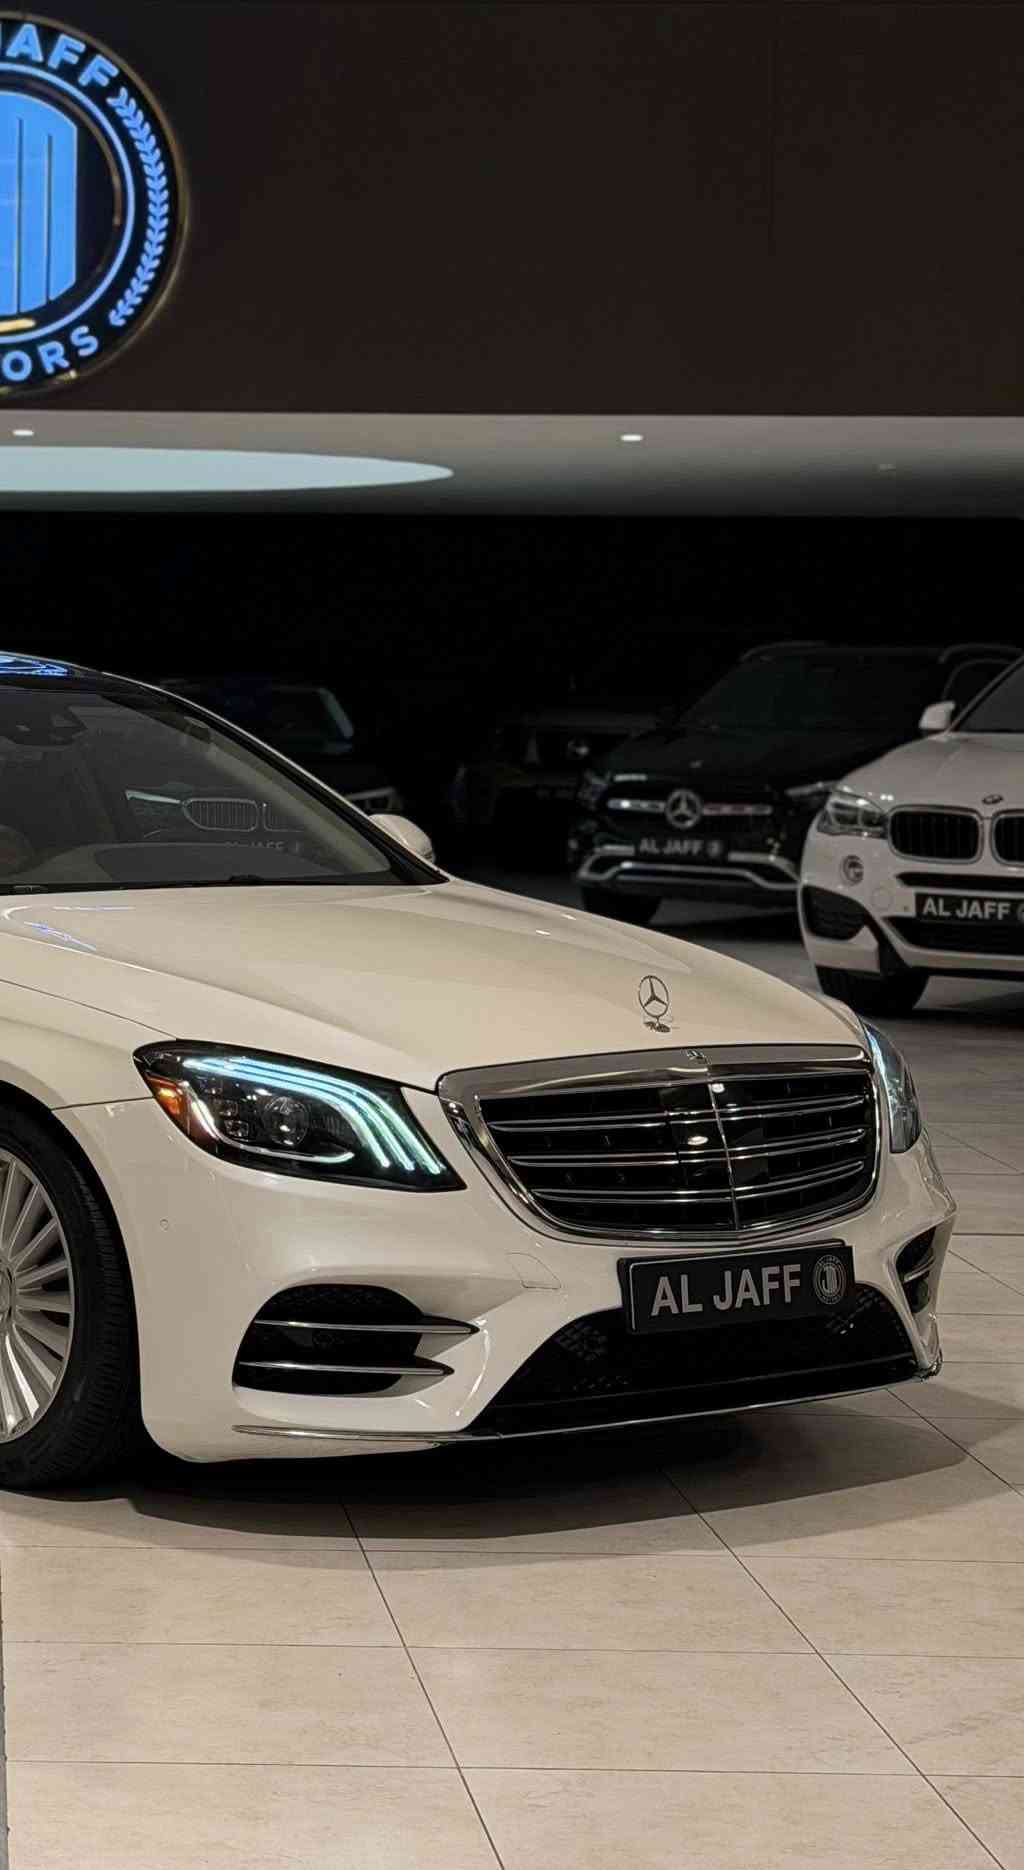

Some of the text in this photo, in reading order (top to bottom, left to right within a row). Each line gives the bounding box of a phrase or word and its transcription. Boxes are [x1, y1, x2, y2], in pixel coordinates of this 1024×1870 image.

[662, 838, 704, 855] JAFF
[922, 896, 1011, 920] AL JAFF
[651, 1274, 703, 1316] AL
[713, 1264, 801, 1311] JAFF
